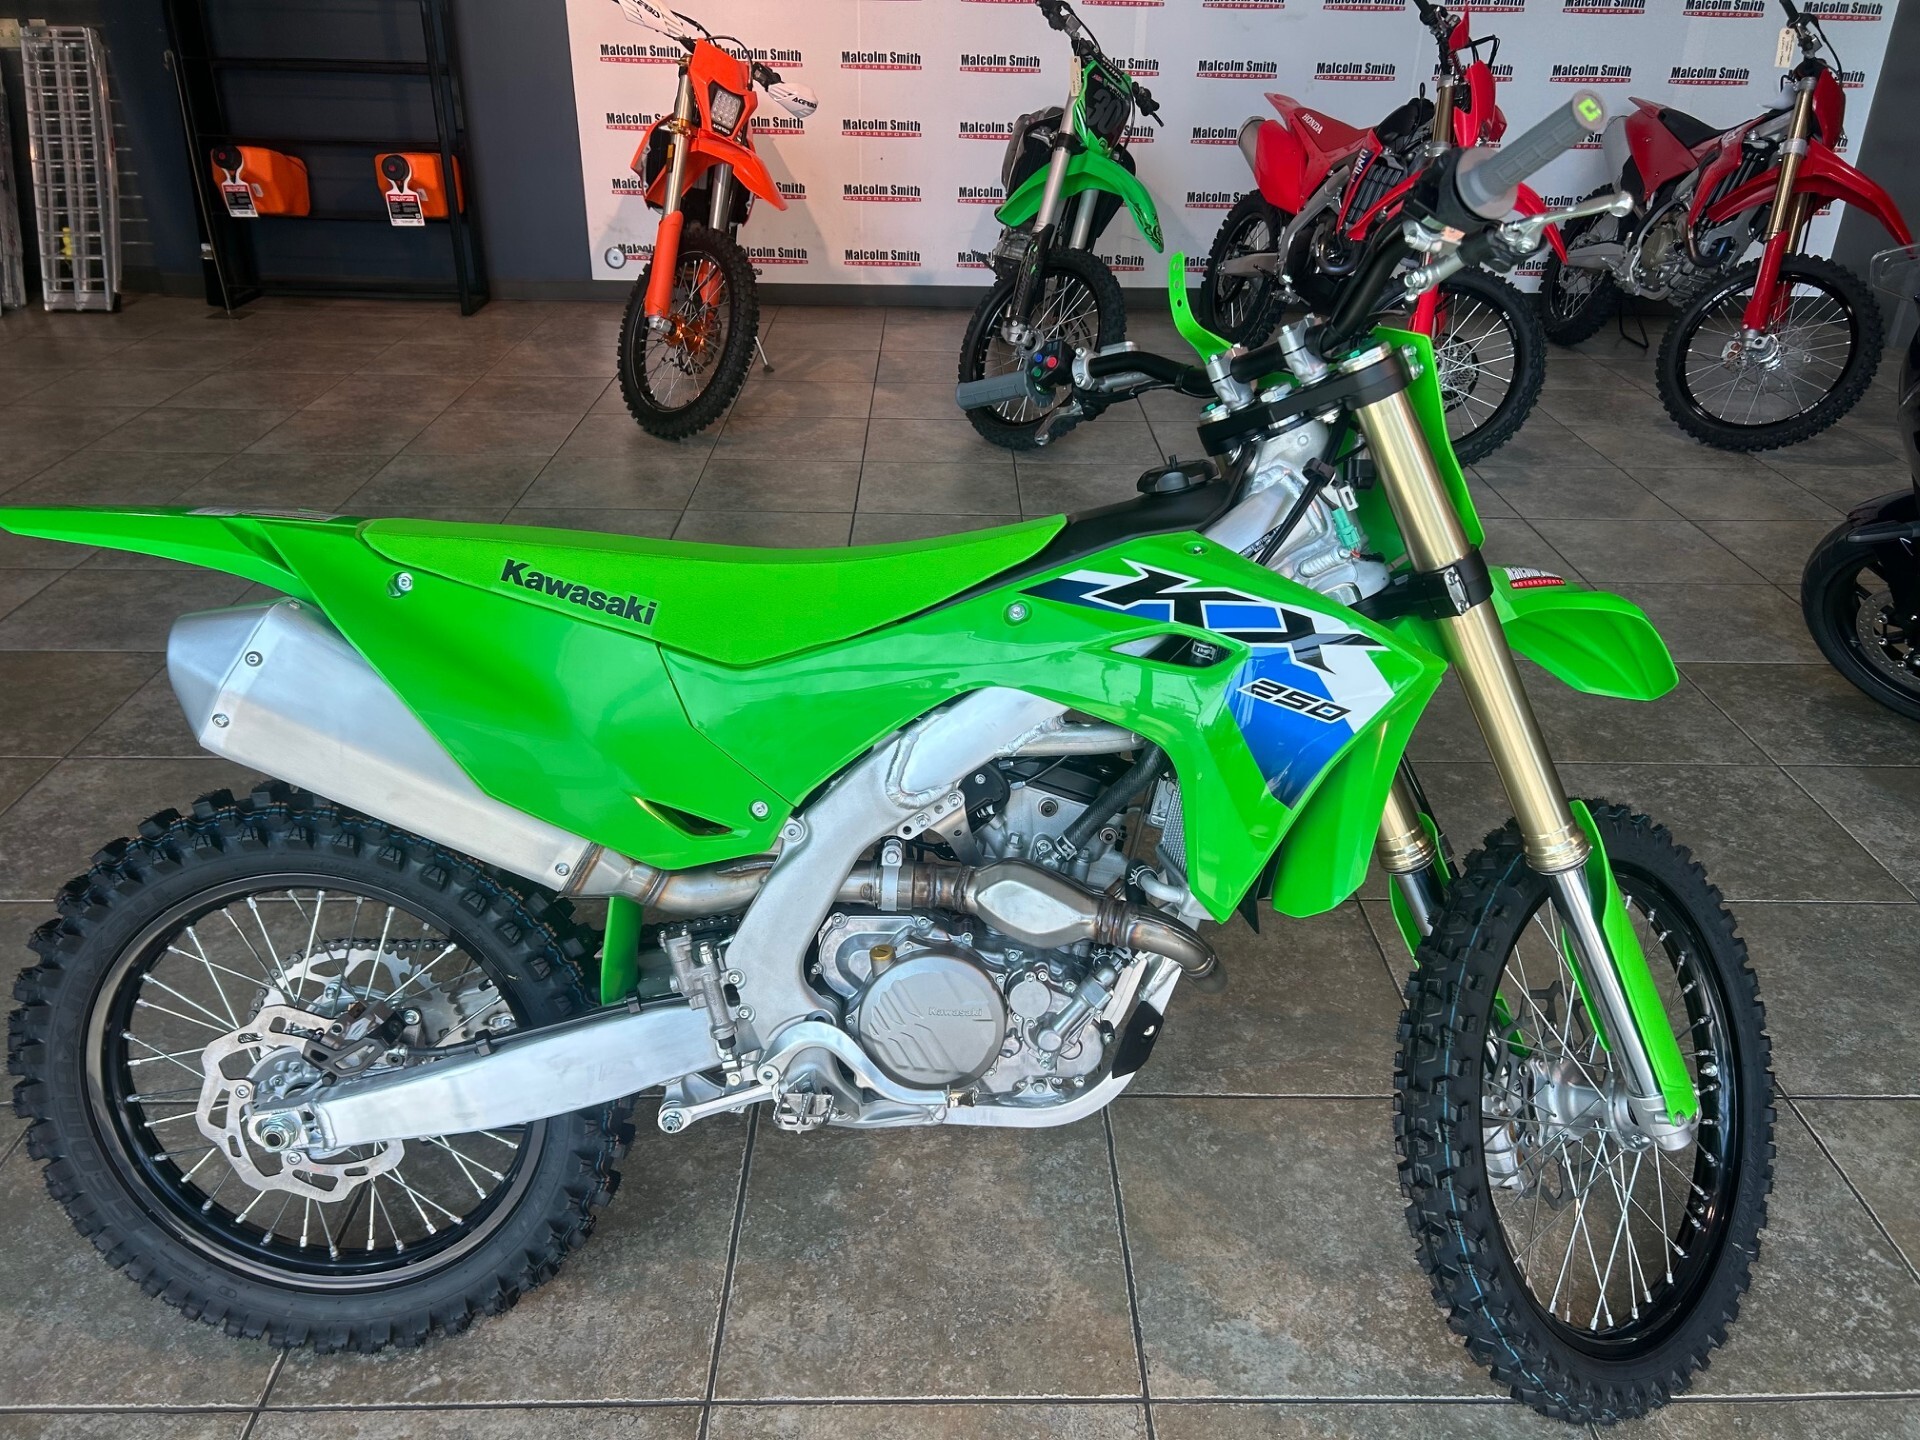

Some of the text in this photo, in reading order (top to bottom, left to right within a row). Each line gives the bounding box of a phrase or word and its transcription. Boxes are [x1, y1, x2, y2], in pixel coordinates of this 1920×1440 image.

[1685, 0, 1765, 12] Malcolm Smith
[1803, 2, 1883, 14] Malcolm Smith
[600, 44, 681, 58] Malcolm Smith
[770, 48, 802, 62] Smith
[841, 51, 921, 64] Malcolm Smith
[961, 54, 1041, 67] Malcolm Smith
[1128, 57, 1159, 70] Smith
[1198, 59, 1277, 73] Malcolm Smith
[1316, 62, 1395, 75] Malcolm Smith
[1552, 64, 1631, 77] Malcolm Smith
[1670, 67, 1749, 80] Malcolm Smith
[606, 113, 652, 125] Malcolm
[772, 116, 804, 129] Smith
[842, 119, 921, 132] Malcolm Smith
[1301, 113, 1324, 135] HONDA
[960, 121, 1005, 133] Malcolm
[1124, 124, 1154, 137] Smith
[1192, 127, 1237, 139] Malcolm
[844, 184, 921, 196] Malcolm Smith
[958, 186, 1003, 198] Malcolm
[1187, 191, 1231, 203] Malcolm
[778, 247, 808, 259] Smith
[845, 249, 920, 262] Malcolm Smith
[1115, 255, 1144, 267] Smith
[1511, 579, 1565, 588] MOTORSPORTS
[500, 558, 658, 626] Kawasaki
[1240, 678, 1352, 723] 250
[928, 1006, 983, 1017] Kawasaki
